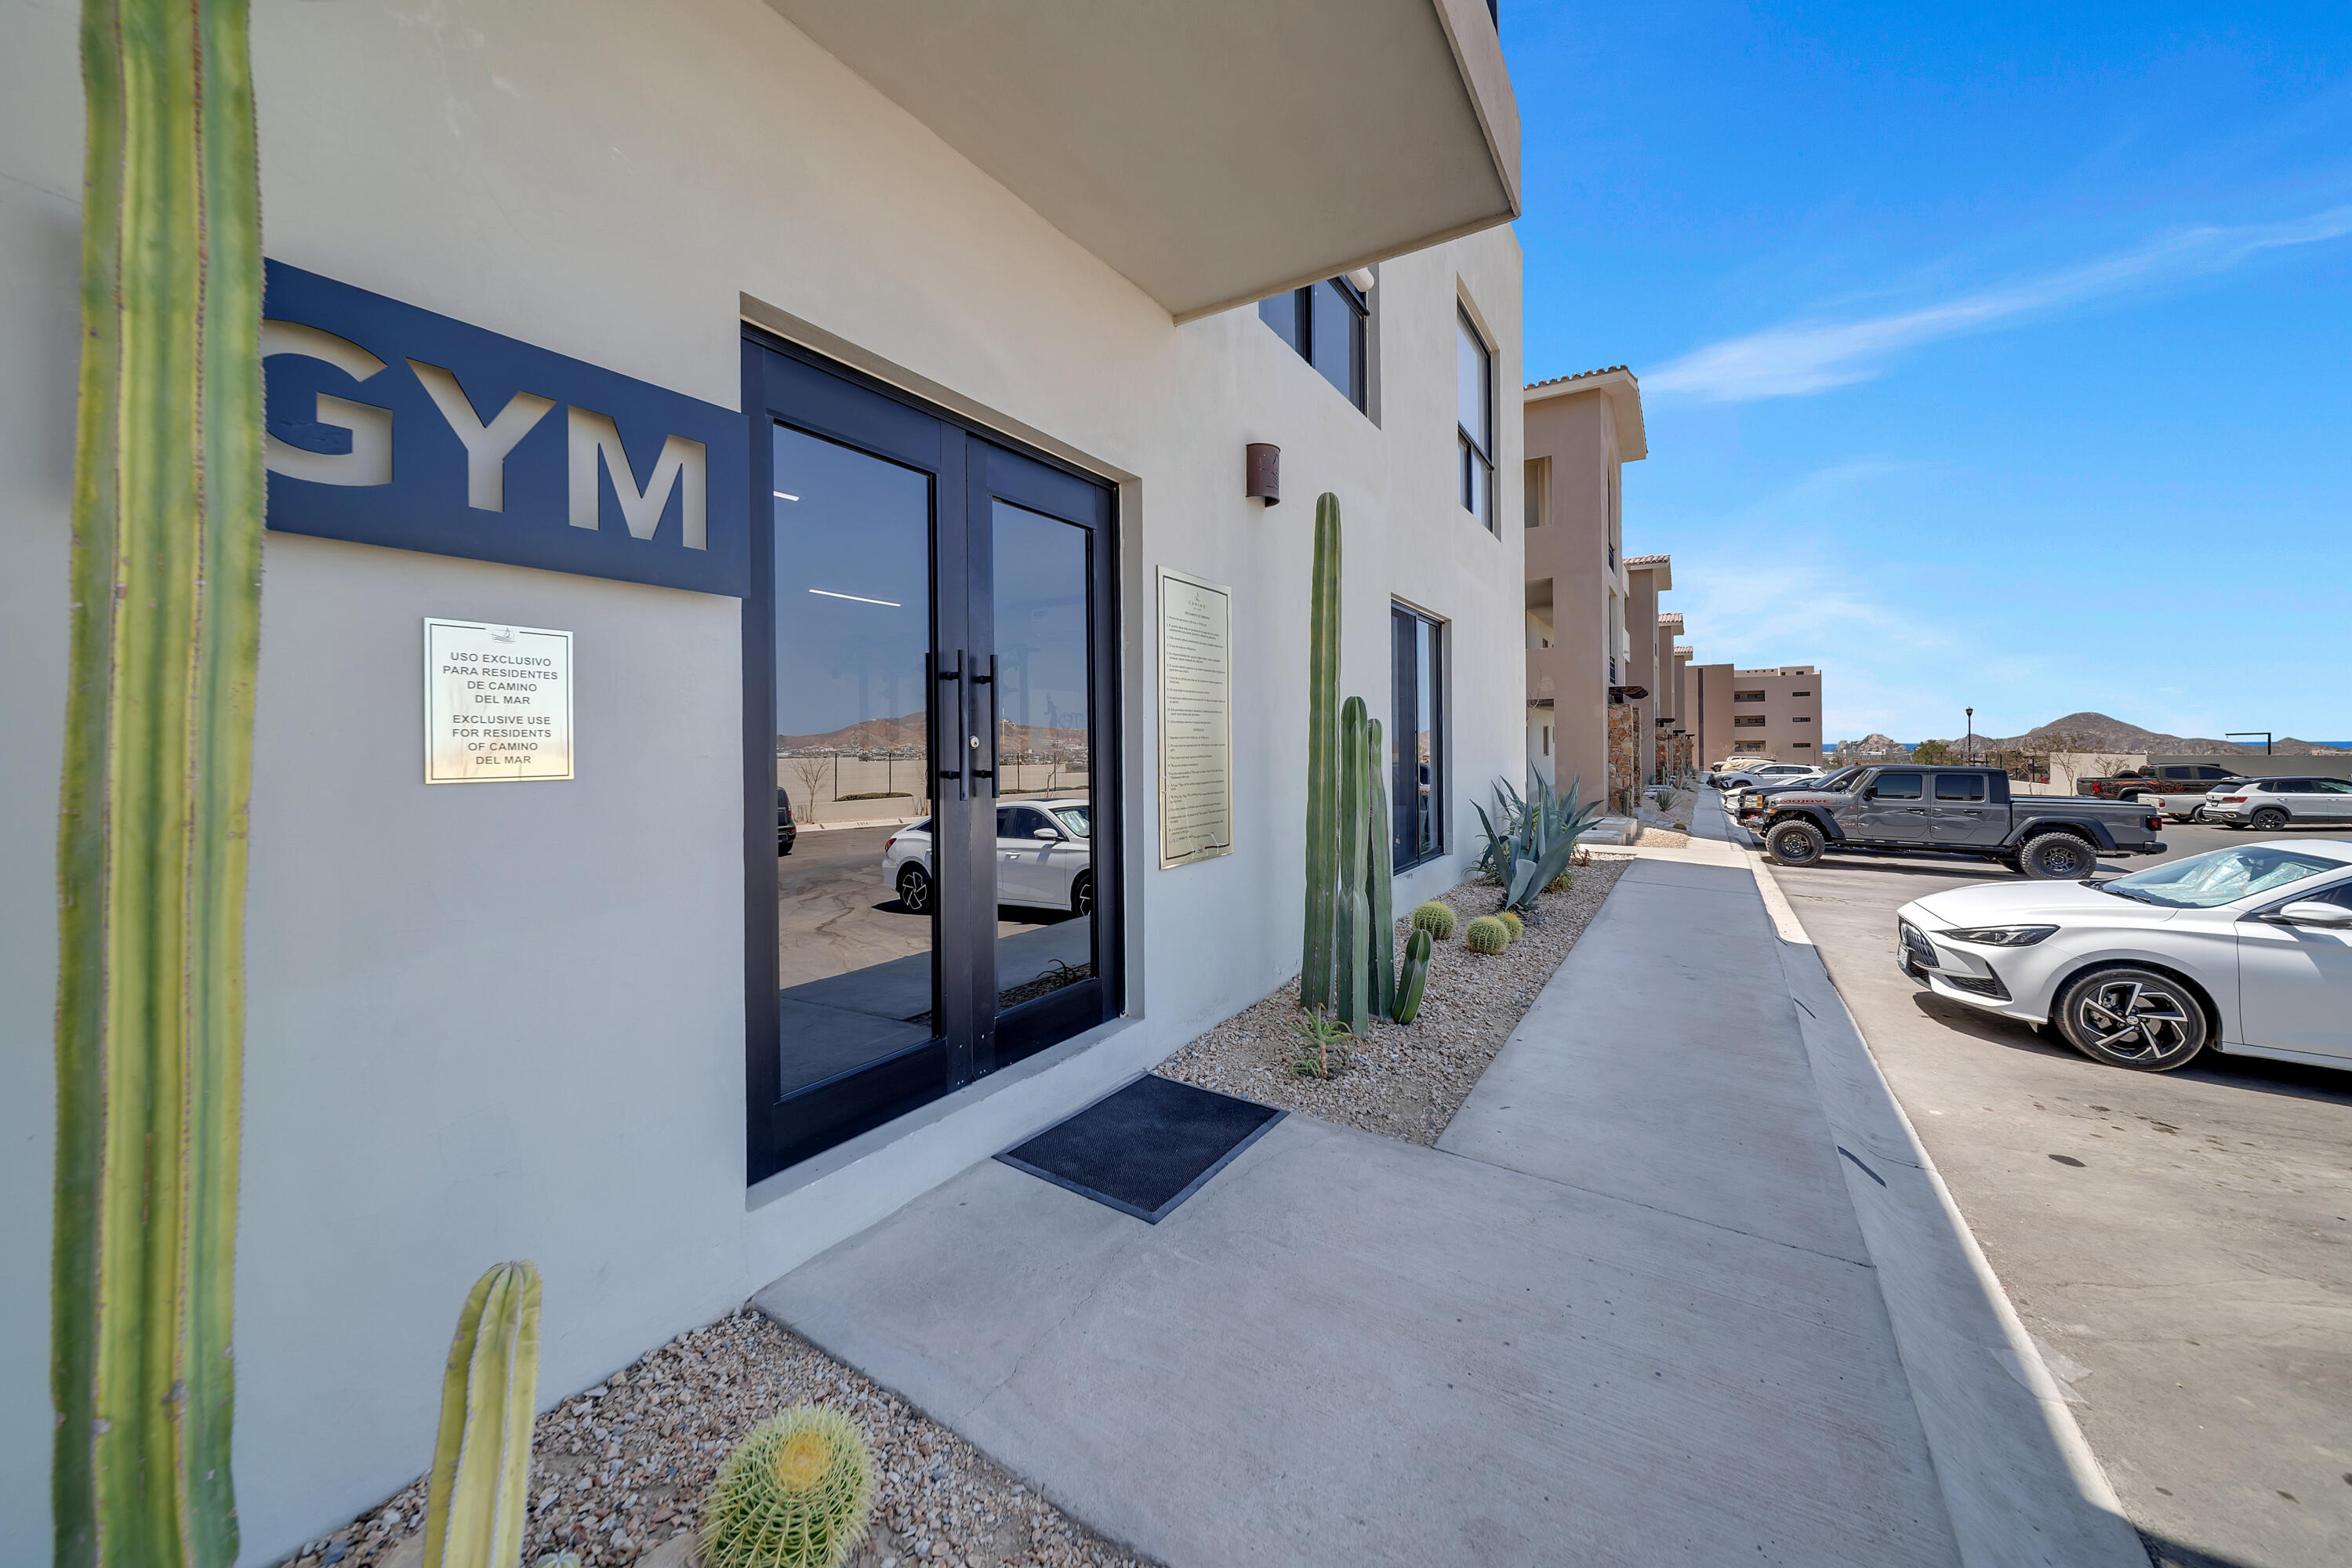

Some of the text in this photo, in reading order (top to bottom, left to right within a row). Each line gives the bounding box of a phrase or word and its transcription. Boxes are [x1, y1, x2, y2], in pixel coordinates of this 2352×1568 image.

[261, 319, 708, 550] GYM
[1189, 601, 1206, 609] CAMINO
[450, 652, 552, 666] USO EXCLUSIVO
[442, 665, 558, 680] PARA RESIDENTES
[467, 681, 538, 692] DE CAMINO
[475, 695, 531, 705] DEL MAR
[452, 714, 551, 724] EXCLUSIVE USE
[452, 728, 552, 738] FOR RESIDENTS
[468, 742, 539, 751] OF CAMINO
[476, 755, 532, 765] DEL MAR
